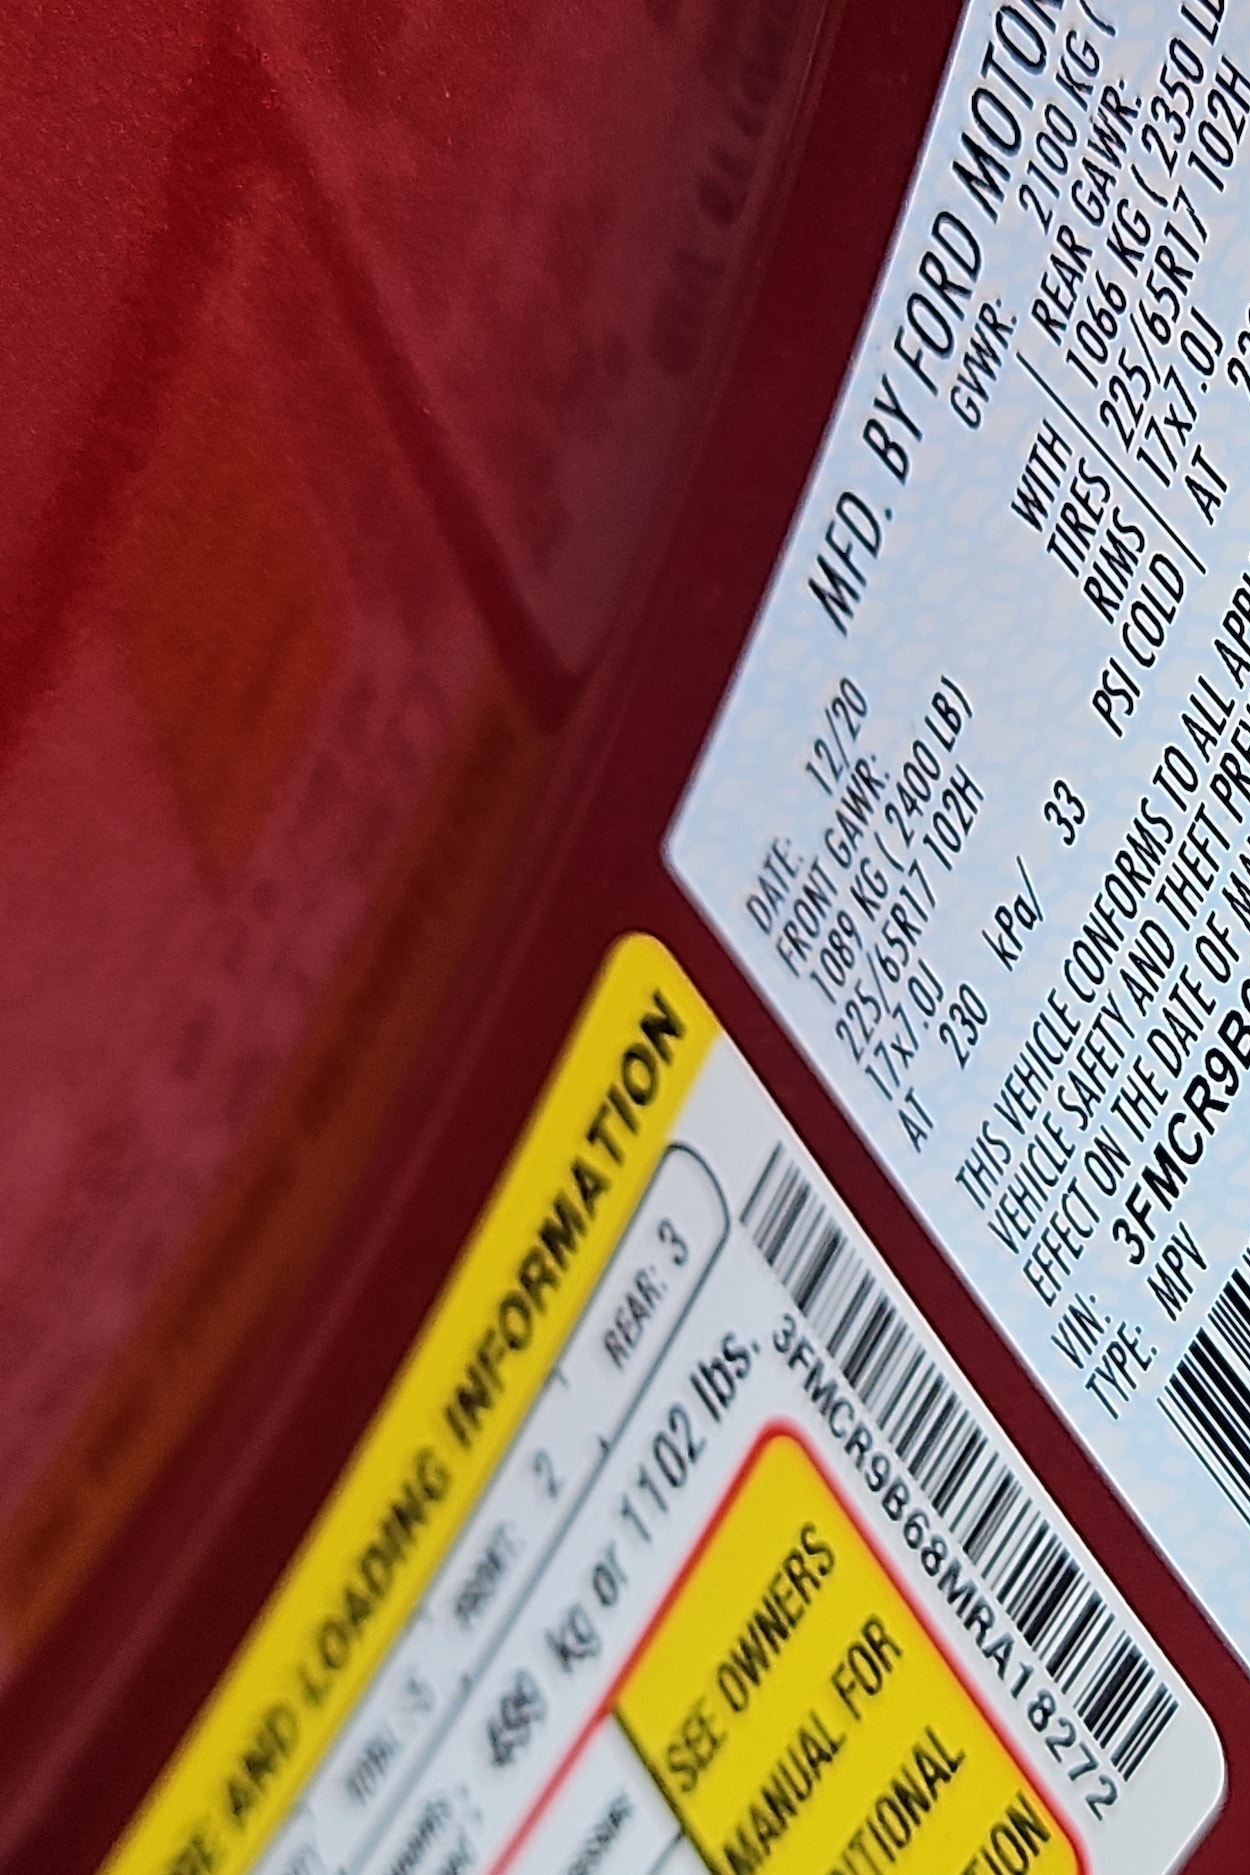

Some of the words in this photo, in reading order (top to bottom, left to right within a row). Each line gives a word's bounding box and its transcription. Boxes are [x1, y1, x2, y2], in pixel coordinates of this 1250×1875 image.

[1140, 36, 1205, 179] 2350
[949, 297, 1018, 431] GVWR:
[1017, 102, 1079, 236] 2100
[1054, 27, 1101, 113] KG
[1030, 223, 1094, 347] REAR
[1070, 78, 1143, 228] GAWR:
[1105, 197, 1152, 278] KG
[1129, 162, 1169, 209] (
[892, 209, 983, 398] FORD
[1065, 269, 1128, 390] 1066
[1098, 183, 1209, 454] 225/65R17
[861, 372, 924, 487] BY
[1135, 305, 1225, 489] 17x7.0J
[1009, 417, 1074, 533] WITH
[1045, 456, 1112, 579] TIRES
[1183, 443, 1228, 527] AT
[806, 490, 893, 638] MFD.
[1082, 504, 1146, 626] RIMS
[923, 674, 974, 754] LB)
[1091, 656, 1142, 739] PSI
[1121, 552, 1185, 669] COLD
[746, 837, 804, 937] DATE:
[804, 676, 868, 797] 12/20
[774, 856, 839, 978] FRONT
[823, 754, 891, 870] GAWR:
[873, 830, 906, 874] (
[883, 738, 942, 849] 2400
[808, 909, 864, 1005] 1089
[834, 858, 937, 1065] 225/65R17
[921, 762, 985, 872] 102H
[848, 855, 889, 923] KG
[897, 1086, 935, 1154] AT
[938, 982, 989, 1071] 230
[980, 855, 1044, 973] kPa/
[1043, 778, 1086, 847] 33
[954, 1119, 1013, 1211] THIS
[992, 987, 1082, 1136] VEHICLE
[1062, 795, 1175, 1004] CONFORMS
[1151, 744, 1200, 813] TO
[1180, 674, 1237, 764] ALL
[863, 958, 945, 1102] 17x7.0J
[986, 1110, 1077, 1255] VEHICLE
[1056, 990, 1136, 1132] SAFETY
[1118, 918, 1176, 1018] AND
[1154, 801, 1232, 932] THEFT
[1021, 1175, 1101, 1308] EFFECT
[1083, 1124, 1132, 1198] ON
[1109, 1053, 1170, 1143] THE
[1145, 963, 1218, 1080] DATE
[1194, 909, 1241, 985] OF
[600, 1261, 671, 1371] REAR:
[654, 1217, 694, 1268] 3
[1049, 1292, 1112, 1370] VIN:
[1084, 1320, 1158, 1421] TYPE:
[1146, 1220, 1208, 1323] MPV
[218, 1695, 303, 1835] AND
[297, 1443, 453, 1709] LOADING
[443, 989, 689, 1453] INFORMATION
[546, 1602, 603, 1674] kg
[592, 1541, 629, 1608] or
[620, 1402, 706, 1544] 1102
[690, 1330, 762, 1424] lbs.
[764, 1318, 1124, 1822] 3FMCR9B68MRA18272
[665, 1698, 728, 1793] SEE
[716, 1519, 841, 1716] OWNERS
[829, 1612, 906, 1724] FOR
